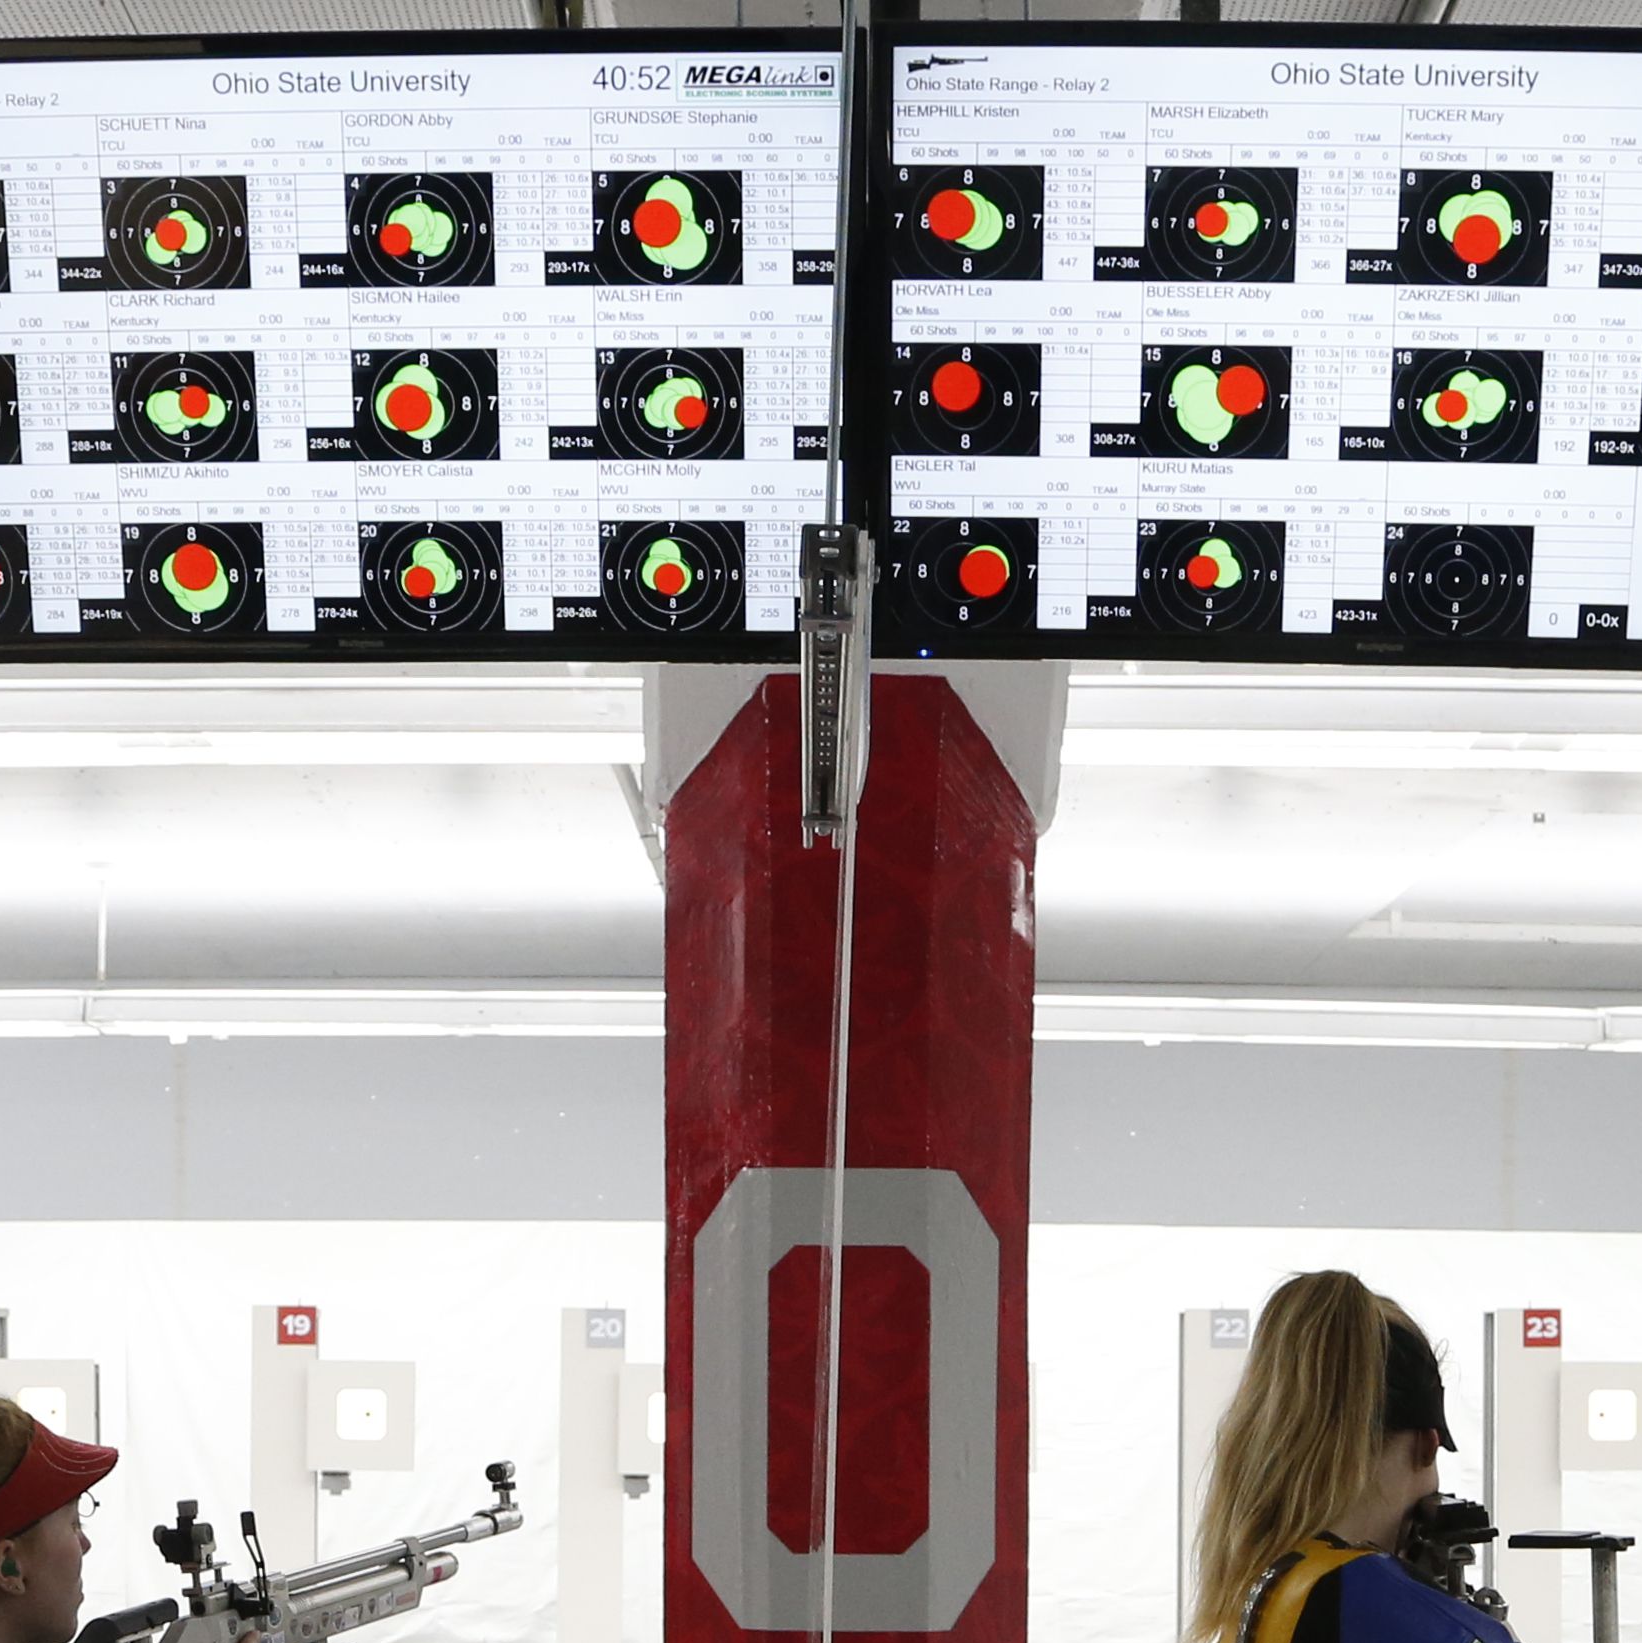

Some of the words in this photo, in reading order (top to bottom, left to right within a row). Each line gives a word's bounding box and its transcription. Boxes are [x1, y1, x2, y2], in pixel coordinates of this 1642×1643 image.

[213, 73, 270, 95] Ohio
[278, 71, 342, 94] State
[351, 69, 471, 96] University
[592, 65, 672, 90] 40:52
[1271, 63, 1330, 85] Ohio
[1339, 63, 1404, 85] State
[1414, 64, 1539, 93] University
[906, 78, 940, 92] Ohio
[945, 78, 984, 92] State
[989, 78, 1037, 94] Range
[1053, 78, 1095, 94] Relay
[1101, 78, 1110, 91] 2
[6, 93, 45, 109] Relay
[51, 93, 59, 106] 2
[896, 106, 970, 117] HEMPHILL
[974, 105, 1020, 117] Kristen
[1151, 107, 1204, 119] MARSH
[1208, 107, 1269, 119] Elizabeth
[1408, 109, 1468, 122] TUCKER
[1472, 110, 1503, 126] Mary
[100, 117, 171, 132] SCHUETT
[176, 117, 206, 130] Nina
[345, 113, 414, 128] GORDON
[419, 113, 453, 130] Abby
[593, 110, 683, 126] GRUNDSØE
[688, 110, 758, 128] Stephanie
[594, 133, 619, 145] TCU
[897, 127, 920, 138] TCU
[1151, 128, 1174, 138] TCU
[1405, 132, 1452, 145] Kentucky
[102, 140, 125, 152] TCU
[346, 135, 371, 147] TCU
[548, 262, 590, 273] 293-17x
[1097, 257, 1140, 269] 447-36x
[61, 267, 102, 280] 344-22x
[302, 264, 344, 277] 244-16x
[351, 290, 413, 305] SIGMON
[417, 289, 460, 304] Hailee
[596, 288, 651, 302] WALSH
[655, 288, 683, 302] Erin
[895, 284, 964, 297] HORVATH
[969, 284, 992, 297] Lea
[1146, 286, 1234, 299] BUESSELER
[1238, 286, 1271, 302] Abby
[110, 294, 159, 308] CLARK
[164, 293, 215, 307] Richard
[1398, 291, 1479, 303] ZAKRZESKI
[1483, 291, 1521, 304] Jillian
[597, 310, 614, 322] Ole
[618, 310, 644, 322] Miss
[895, 306, 912, 316] Ole
[916, 305, 939, 316] Miss
[1146, 308, 1163, 318] Ole
[1167, 308, 1190, 318] Miss
[1398, 311, 1417, 322] Ole
[1420, 311, 1442, 322] Miss
[110, 315, 159, 328] Kentucky
[352, 312, 402, 325] Kentucky
[552, 437, 593, 448] 242-13x
[1093, 434, 1136, 445] 308-27x
[1344, 437, 1385, 448] 165-10x
[1594, 440, 1634, 455] 192-9x
[358, 463, 421, 477] SMOYER
[426, 462, 473, 477] Calista
[600, 463, 662, 477] MCGHIN
[666, 462, 702, 478] Molly
[895, 459, 952, 473] ENGLER
[957, 459, 976, 473] Tal
[1142, 462, 1187, 475] KIURU
[1191, 462, 1233, 475] Matias
[119, 466, 179, 480] SHIMIZU
[184, 466, 229, 479] Akihito
[358, 485, 386, 496] WVU
[600, 484, 628, 495] WVU
[894, 481, 921, 491] WVU
[1142, 483, 1176, 496] Murray
[1179, 483, 1205, 494] State
[120, 488, 148, 498] WVU
[318, 607, 358, 619] 278-24x
[1336, 610, 1377, 621] 423-31x
[1587, 612, 1619, 628] 0-0x
[282, 1314, 311, 1336] 19
[590, 1317, 621, 1338] 20
[1214, 1318, 1246, 1338] 22
[1526, 1317, 1558, 1338] 23
